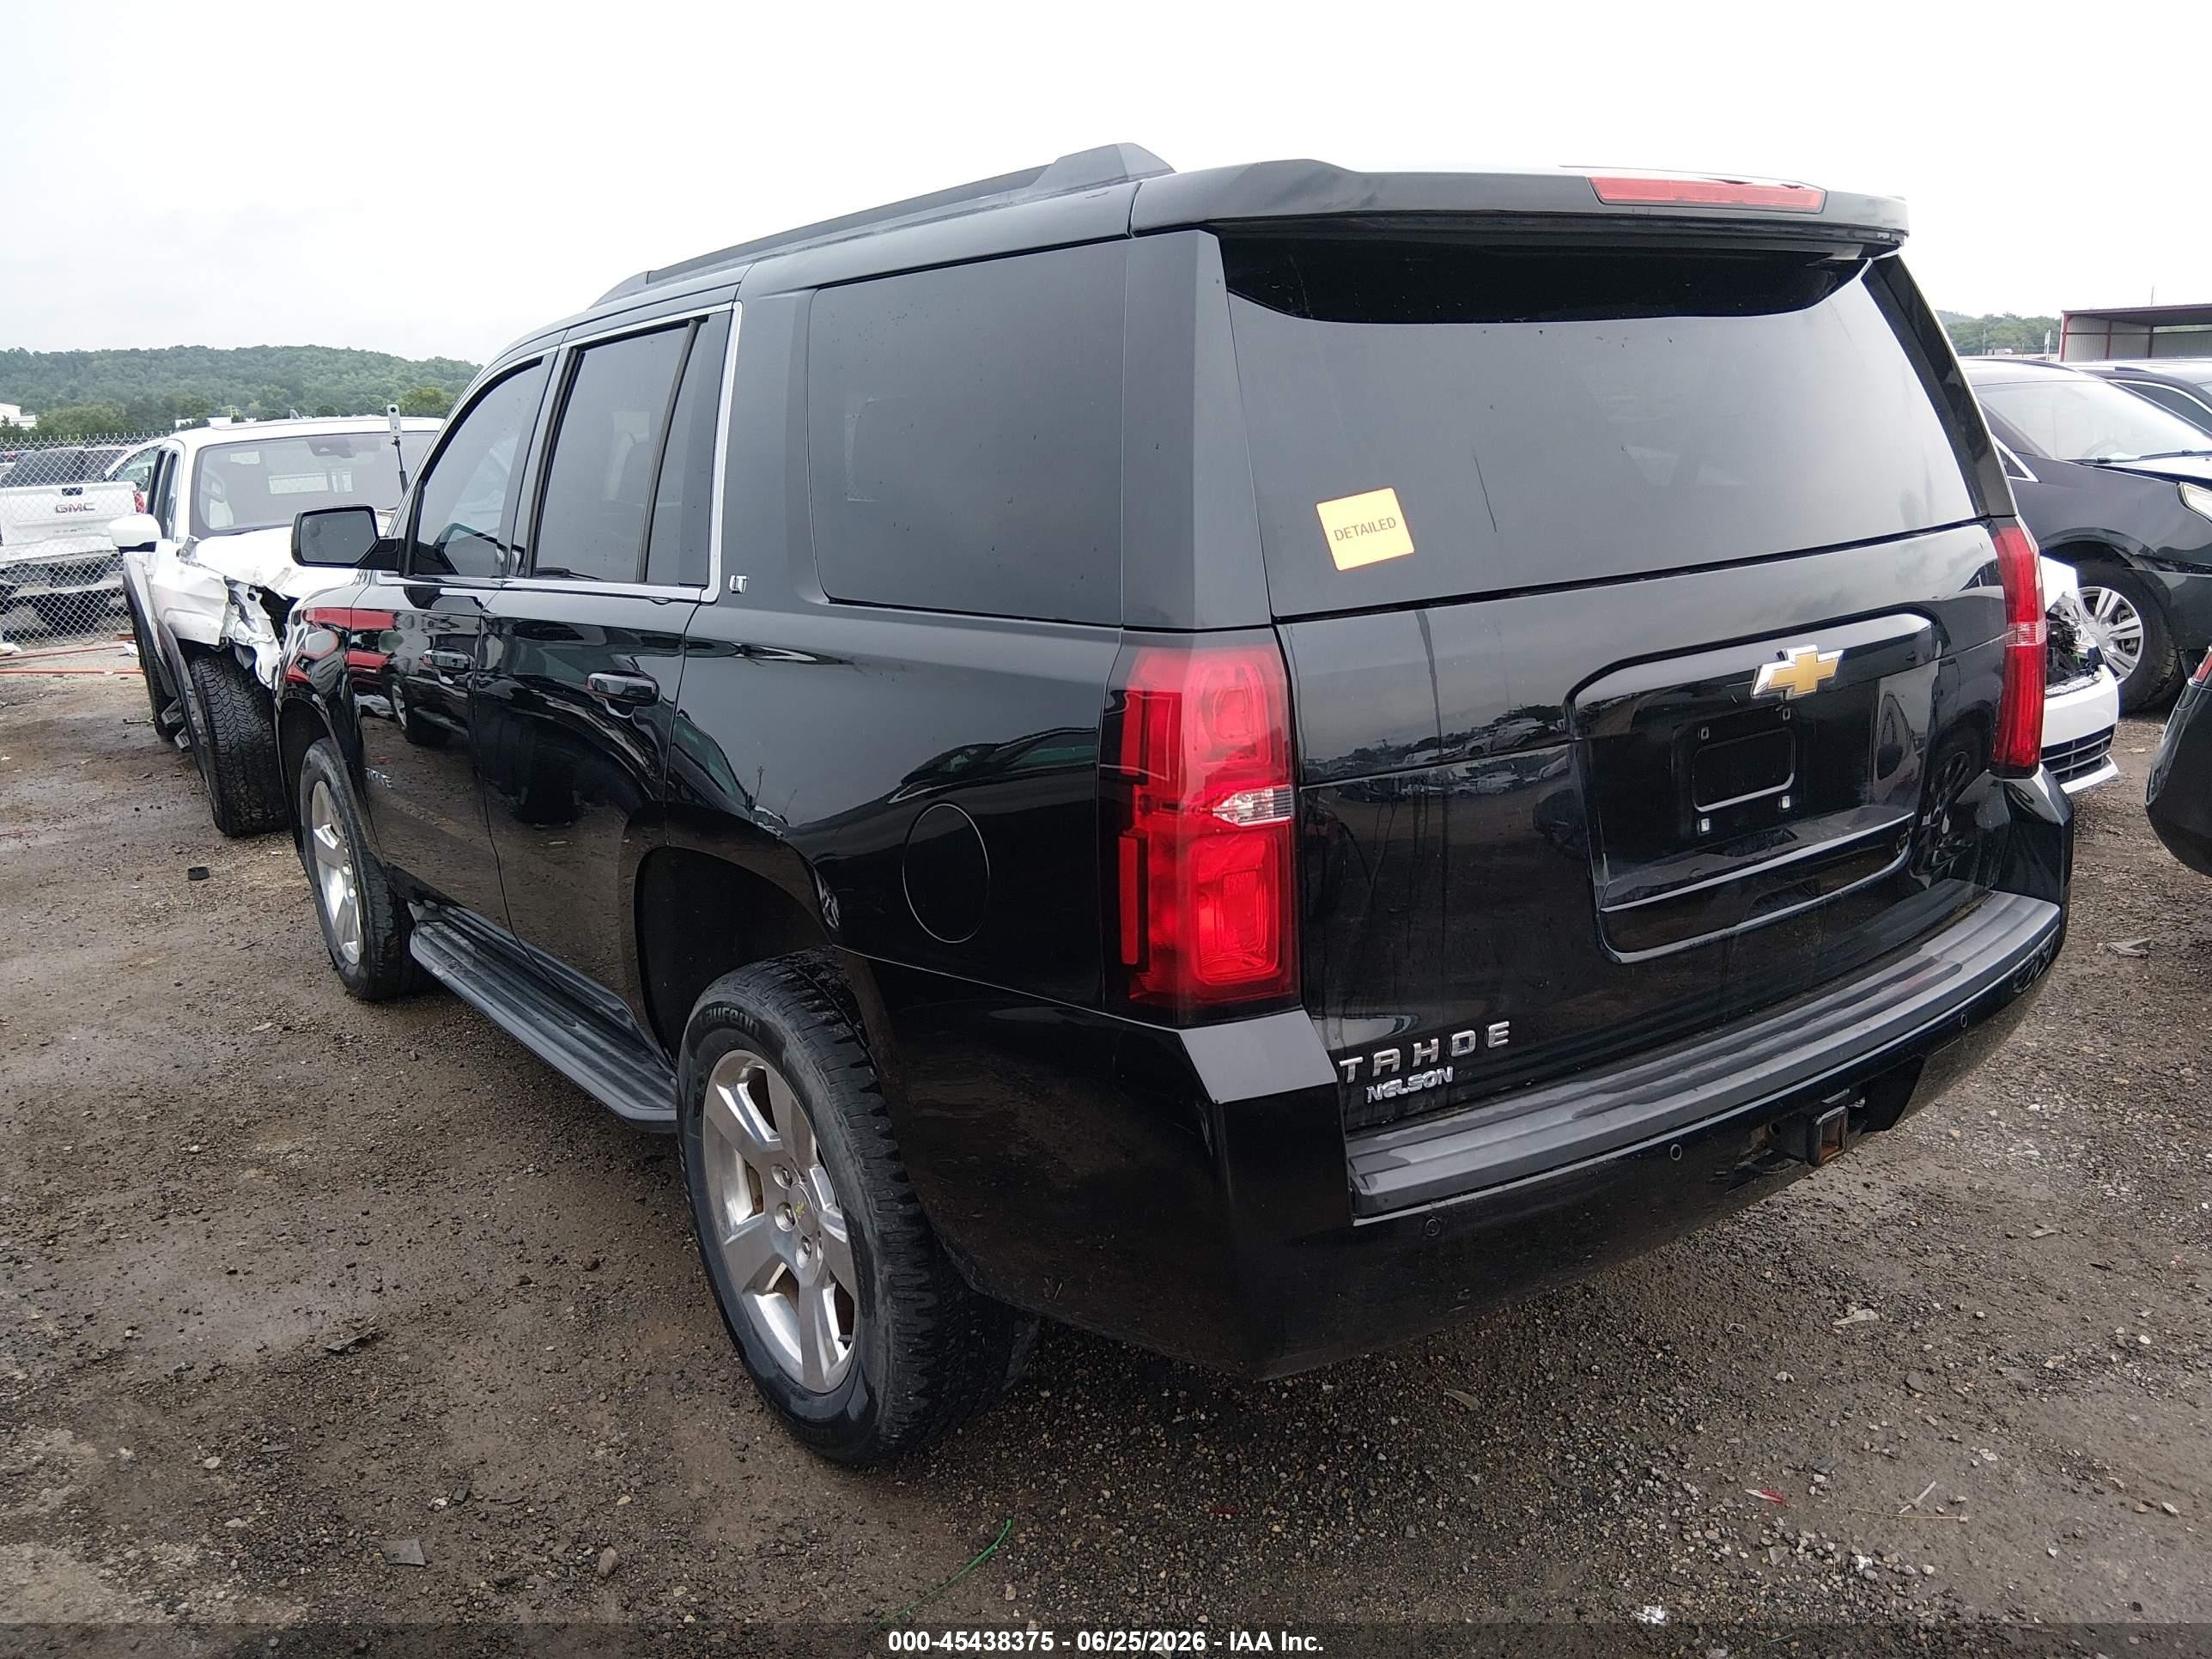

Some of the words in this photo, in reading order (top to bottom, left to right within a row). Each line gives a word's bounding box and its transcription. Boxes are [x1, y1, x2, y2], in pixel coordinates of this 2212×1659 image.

[55, 502, 96, 514] GMC
[1333, 517, 1397, 541] DETAILED
[728, 574, 750, 594] LT
[1339, 1020, 1510, 1084] TAHOE
